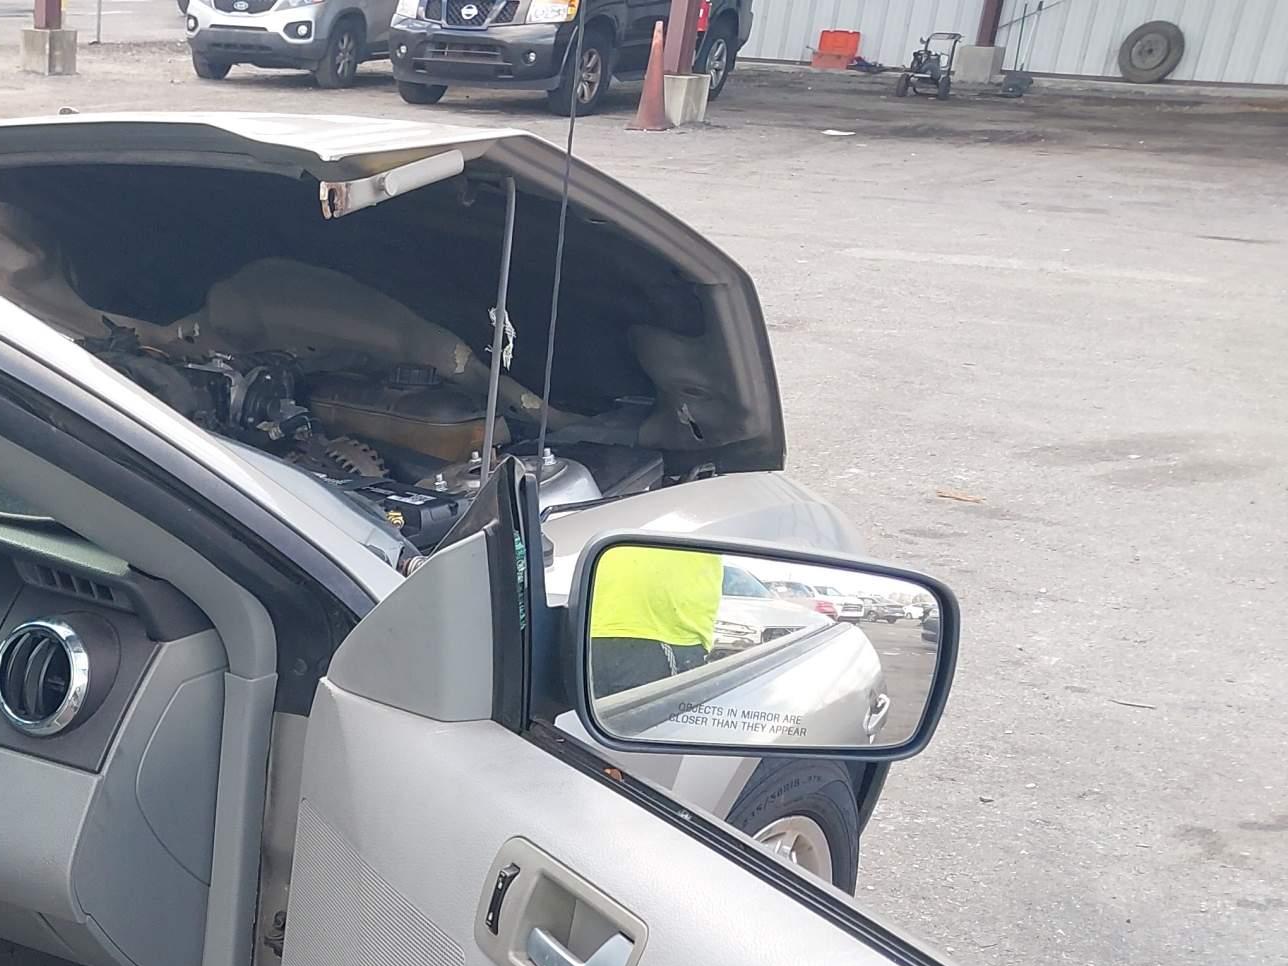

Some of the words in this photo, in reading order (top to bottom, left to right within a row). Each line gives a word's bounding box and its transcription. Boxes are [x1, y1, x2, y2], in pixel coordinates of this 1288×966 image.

[669, 713, 708, 726] CLOSER
[711, 718, 738, 730] THAN
[741, 721, 767, 733] THEY
[769, 725, 808, 737] APPEAR
[678, 702, 723, 717] OBJECTS
[727, 707, 738, 718] IN
[741, 710, 781, 723] MIRROR
[783, 715, 802, 725] ARE
